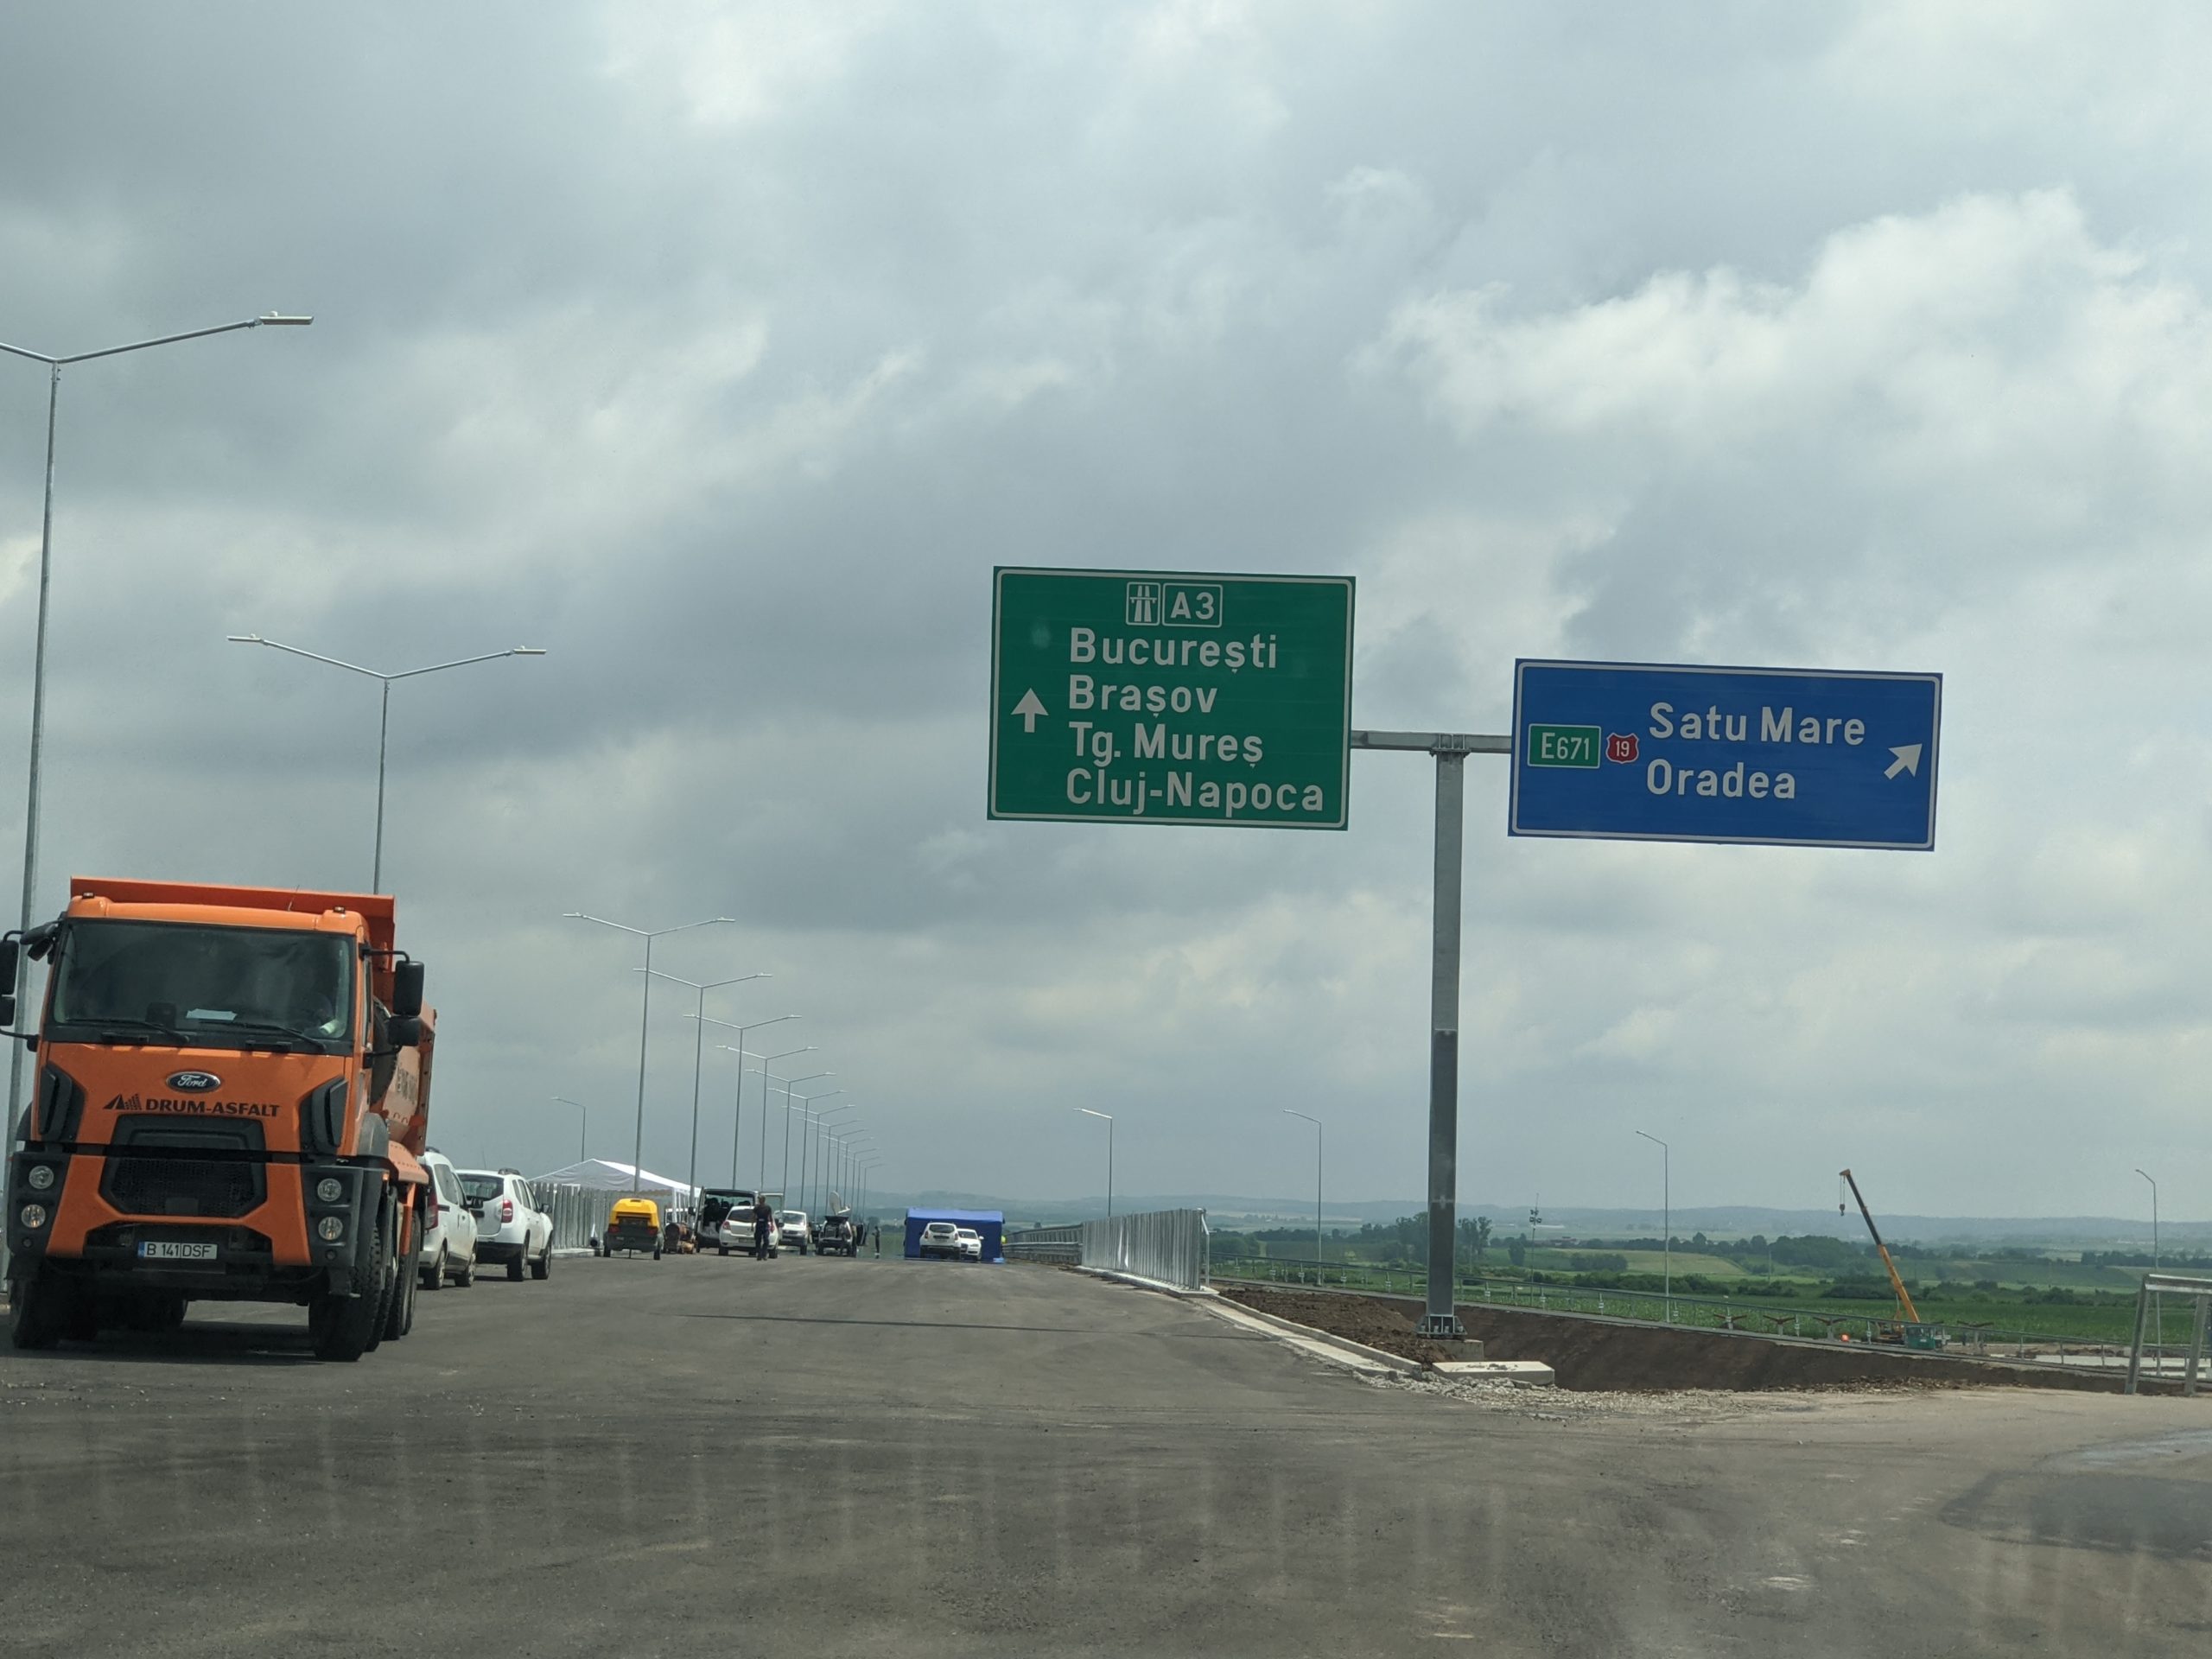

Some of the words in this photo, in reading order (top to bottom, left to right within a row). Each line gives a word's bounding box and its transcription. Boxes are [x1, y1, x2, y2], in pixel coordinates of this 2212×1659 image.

[1170, 592, 1215, 620] A3
[1070, 627, 1277, 674] București
[1069, 675, 1217, 718] Brașov
[1649, 702, 1746, 741] Satu
[1760, 706, 1866, 746] Mare
[1068, 721, 1121, 767] Tg.
[1134, 723, 1263, 768] Mureș
[1541, 732, 1590, 760] E671
[1616, 741, 1630, 757] 19
[1066, 767, 1324, 818] Cluj-Napoca
[1647, 759, 1796, 799] Oradea
[177, 1074, 207, 1087] Ford
[145, 1098, 280, 1117] DRUM-ASFALT
[146, 1243, 156, 1255] B
[162, 1244, 179, 1256] 141
[182, 1245, 212, 1257] DSF
